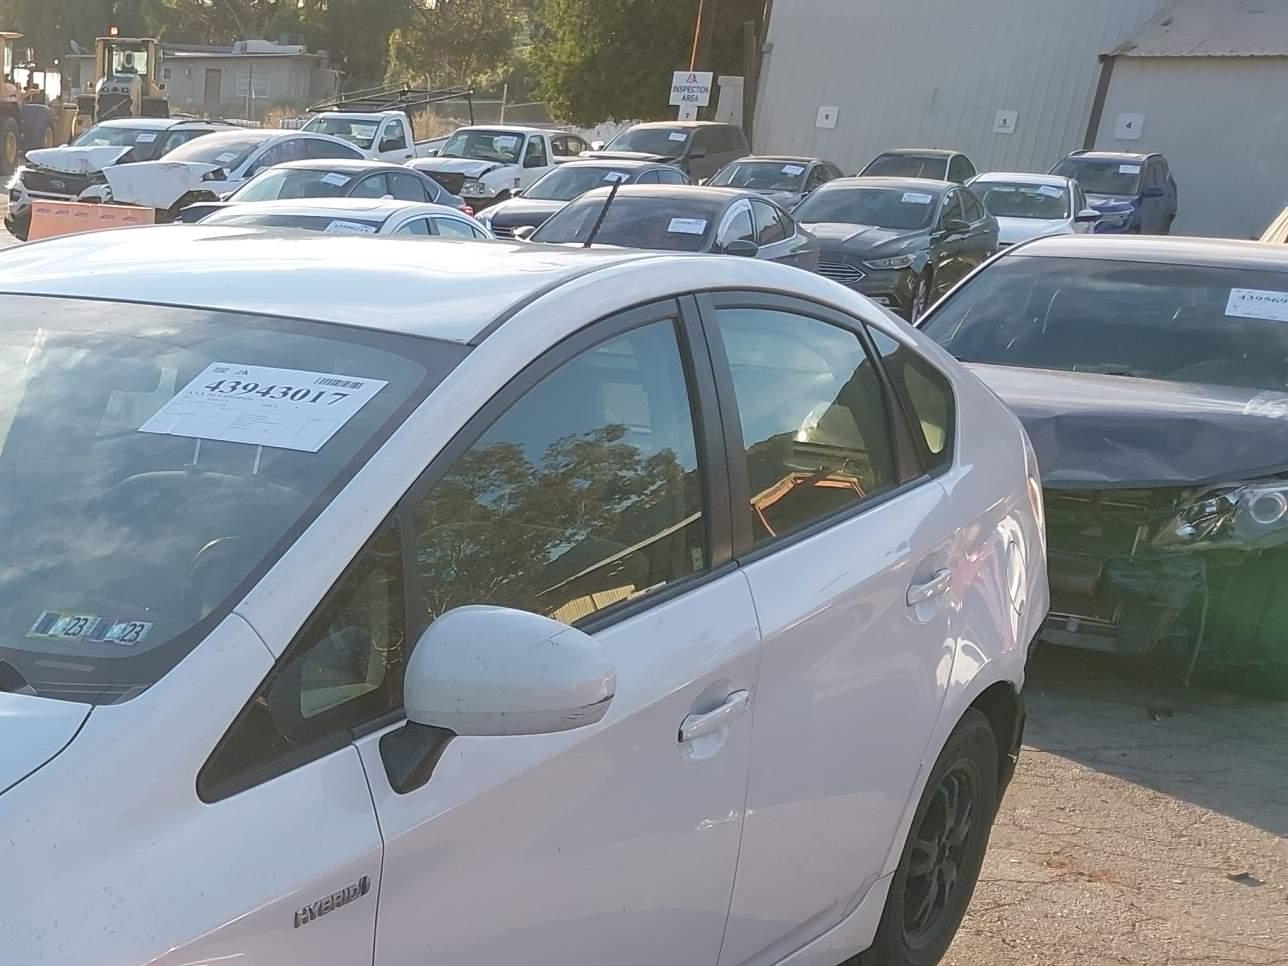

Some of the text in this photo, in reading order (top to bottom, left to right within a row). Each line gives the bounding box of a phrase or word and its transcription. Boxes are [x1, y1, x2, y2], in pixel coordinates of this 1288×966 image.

[205, 379, 352, 406] 43943017
[64, 617, 88, 636] 23
[120, 623, 144, 642] 23
[294, 884, 361, 928] HYBRID
